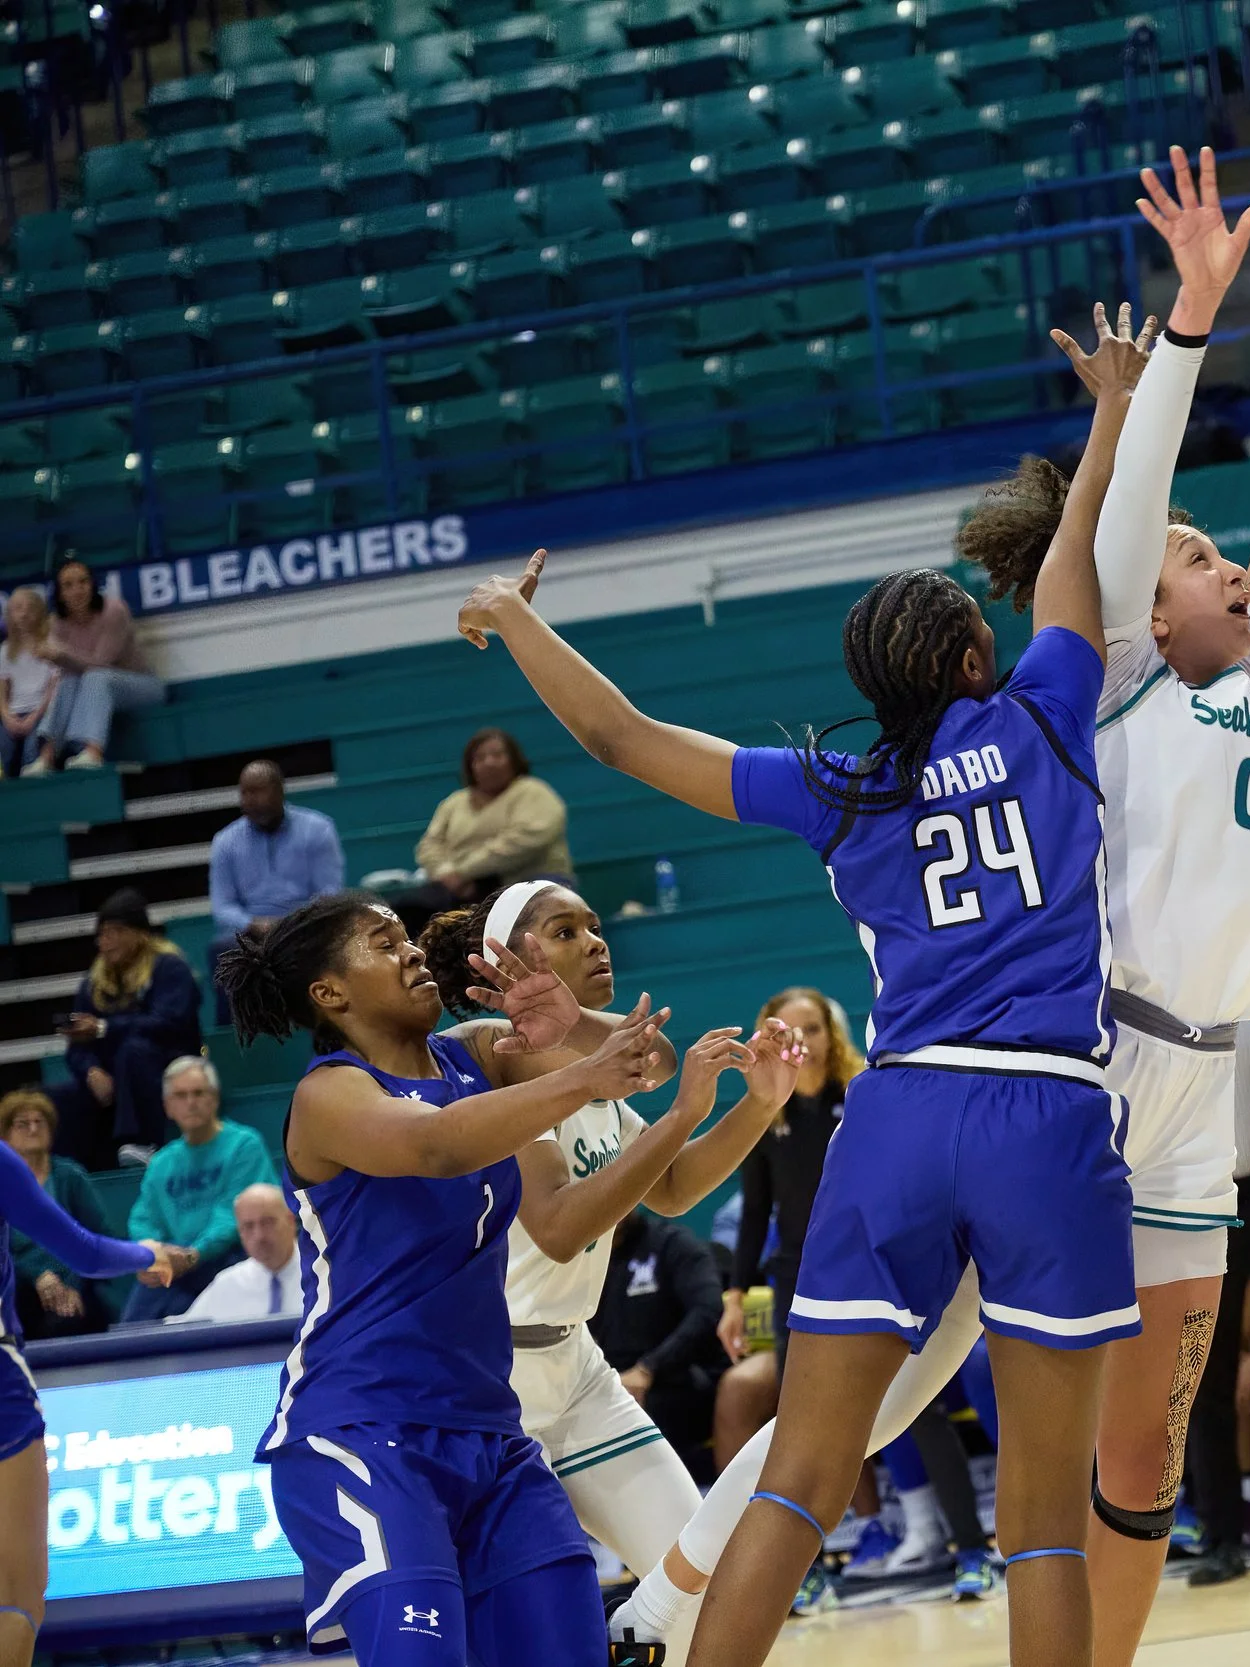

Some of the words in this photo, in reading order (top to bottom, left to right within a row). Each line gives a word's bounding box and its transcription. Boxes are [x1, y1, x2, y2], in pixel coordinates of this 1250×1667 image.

[138, 515, 468, 609] BLEACHERS
[922, 744, 1009, 801] DABO
[913, 795, 1047, 930] 24
[475, 1183, 494, 1249] 1
[64, 1423, 234, 1472] Education
[48, 1463, 283, 1554] ottery
